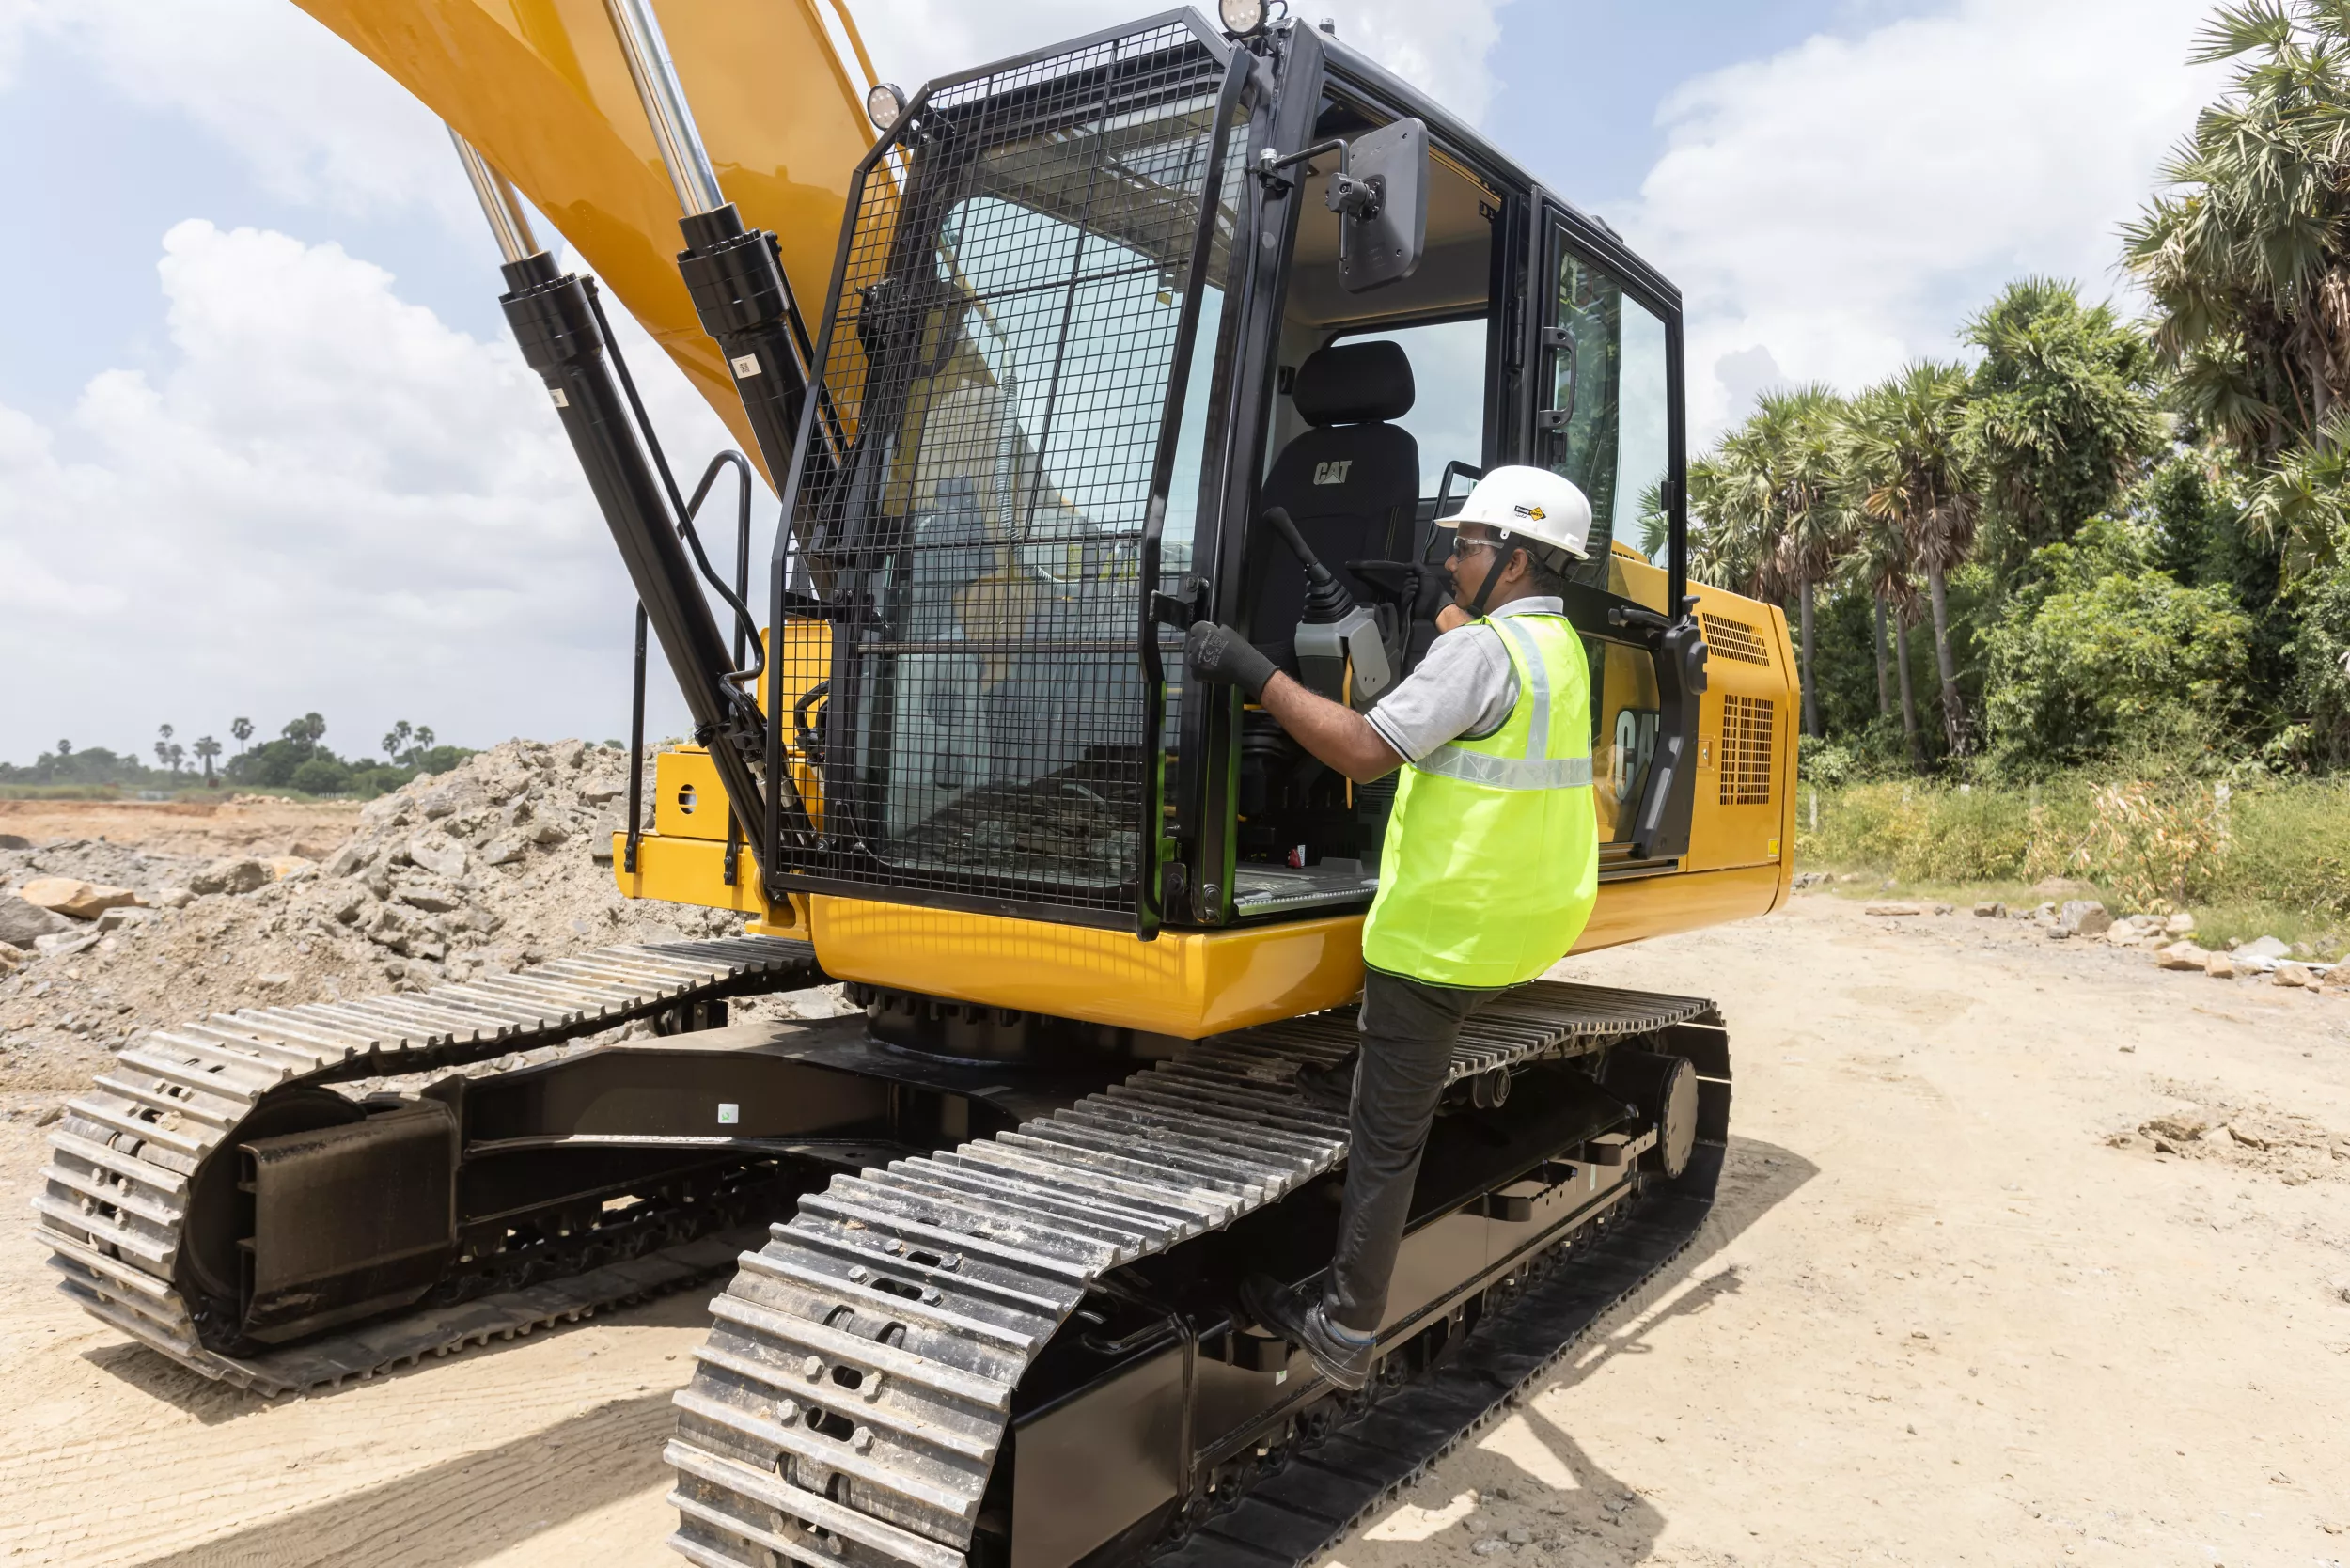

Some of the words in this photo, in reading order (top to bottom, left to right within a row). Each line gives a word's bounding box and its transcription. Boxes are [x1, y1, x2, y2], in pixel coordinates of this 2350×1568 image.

[1313, 460, 1353, 485] CAT
[1203, 649, 1214, 662] CE
[1615, 710, 1660, 800] CA
